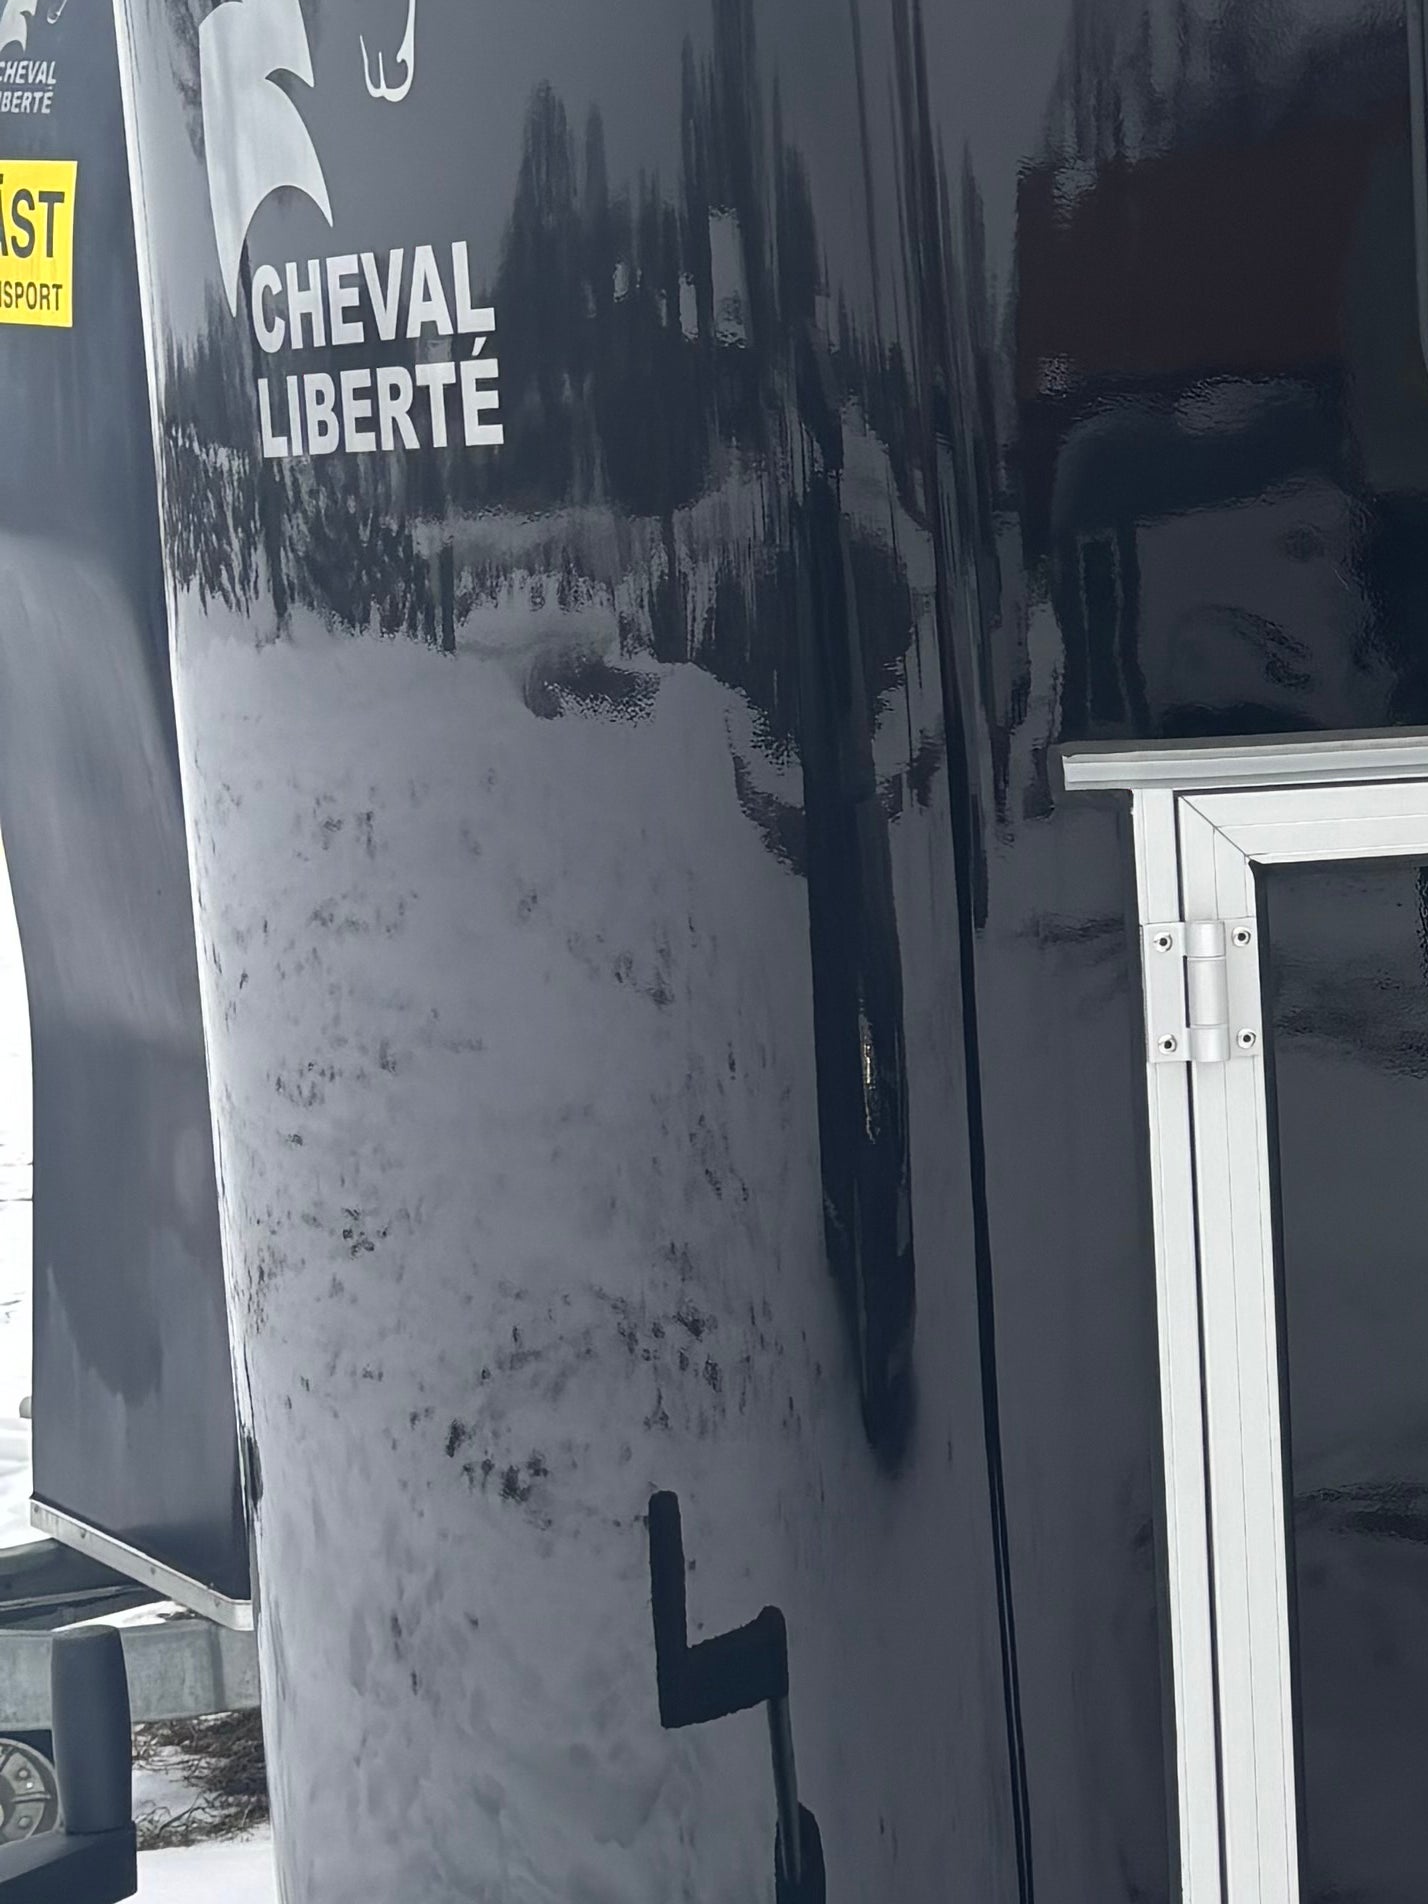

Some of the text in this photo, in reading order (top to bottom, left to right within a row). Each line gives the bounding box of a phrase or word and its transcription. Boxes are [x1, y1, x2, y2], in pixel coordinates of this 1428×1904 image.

[0, 281, 63, 311] SPORT
[251, 241, 496, 353] CHEVAL
[258, 337, 504, 458] LIBERTÉ
